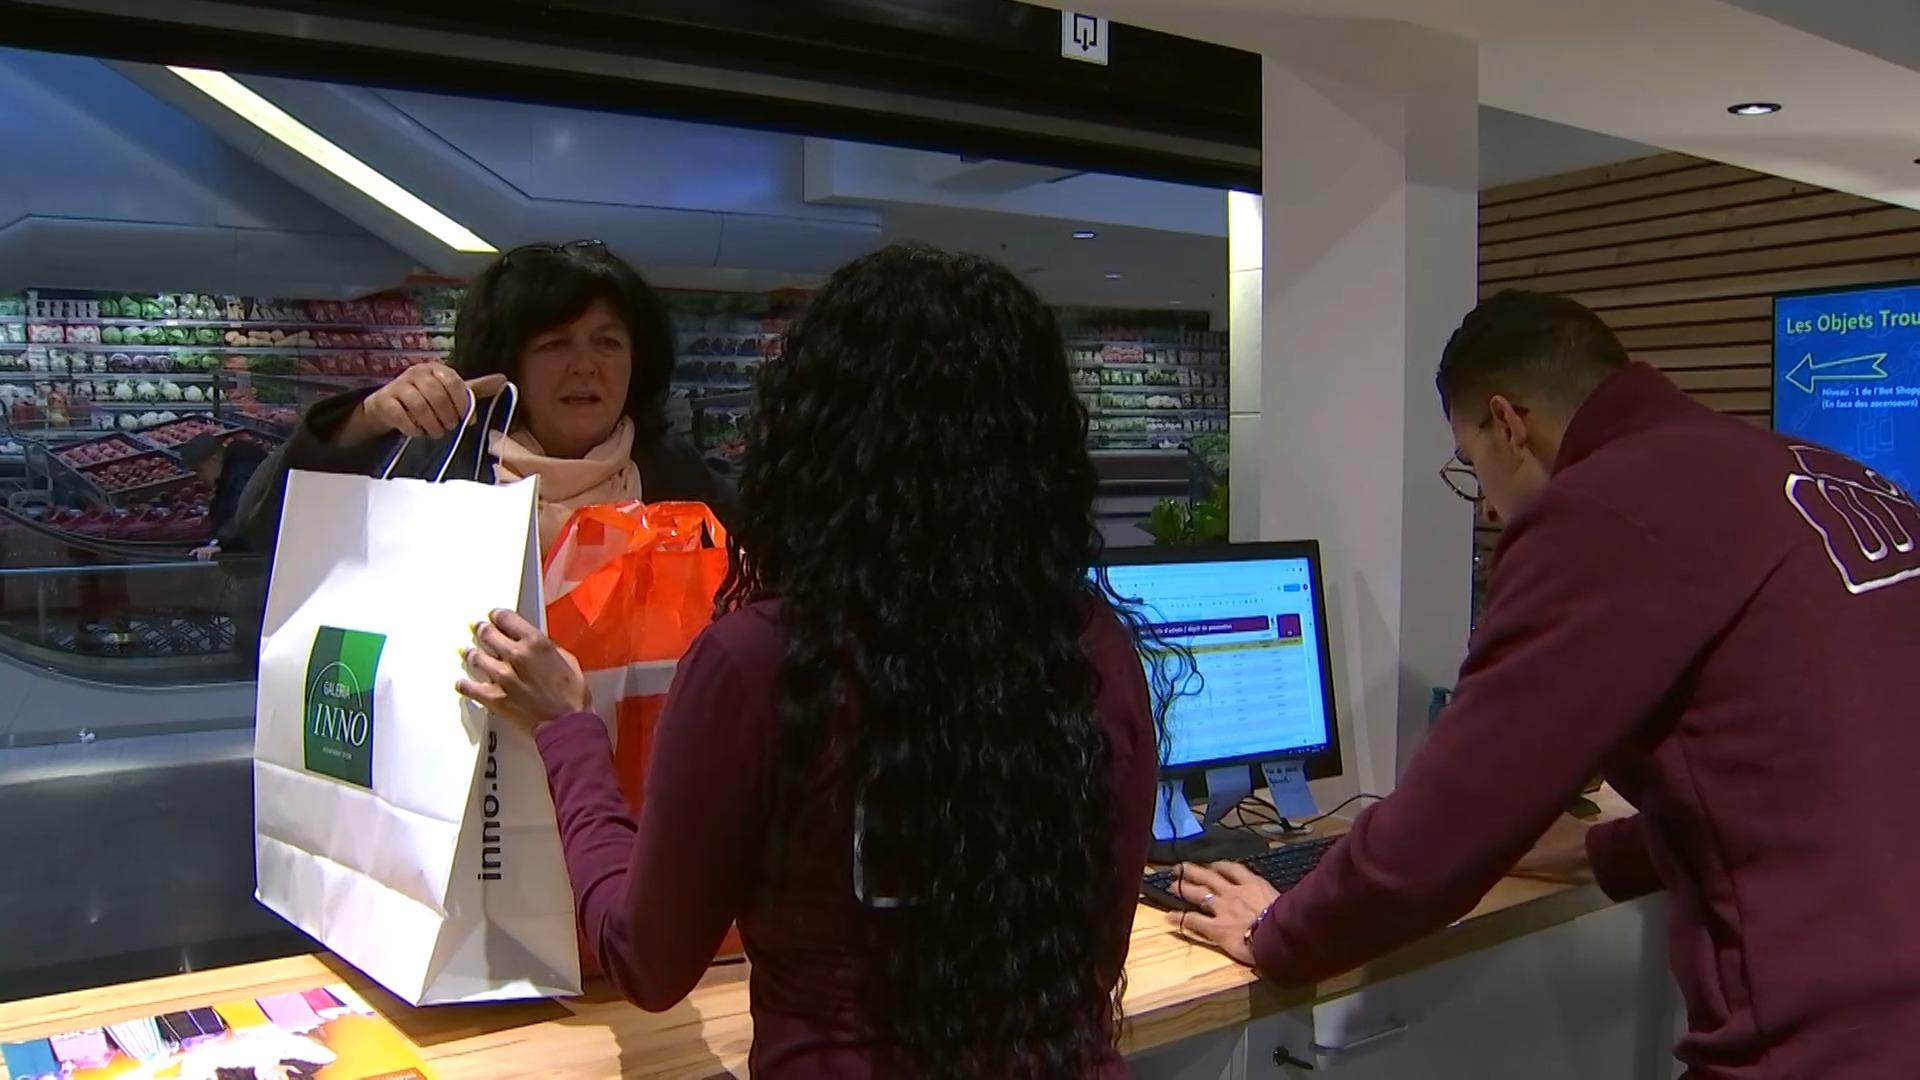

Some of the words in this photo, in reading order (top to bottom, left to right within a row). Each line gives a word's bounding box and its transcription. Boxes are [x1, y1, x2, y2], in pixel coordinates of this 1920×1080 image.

[1787, 317, 1812, 335] Les
[1817, 311, 1873, 336] Objets
[1879, 308, 1920, 328] Trou
[1861, 386, 1872, 396] de
[1836, 398, 1852, 408] face
[1854, 399, 1868, 408] des
[1870, 397, 1918, 408] ascenseurs)
[323, 680, 351, 699] GALERIA
[314, 703, 368, 747] INNO
